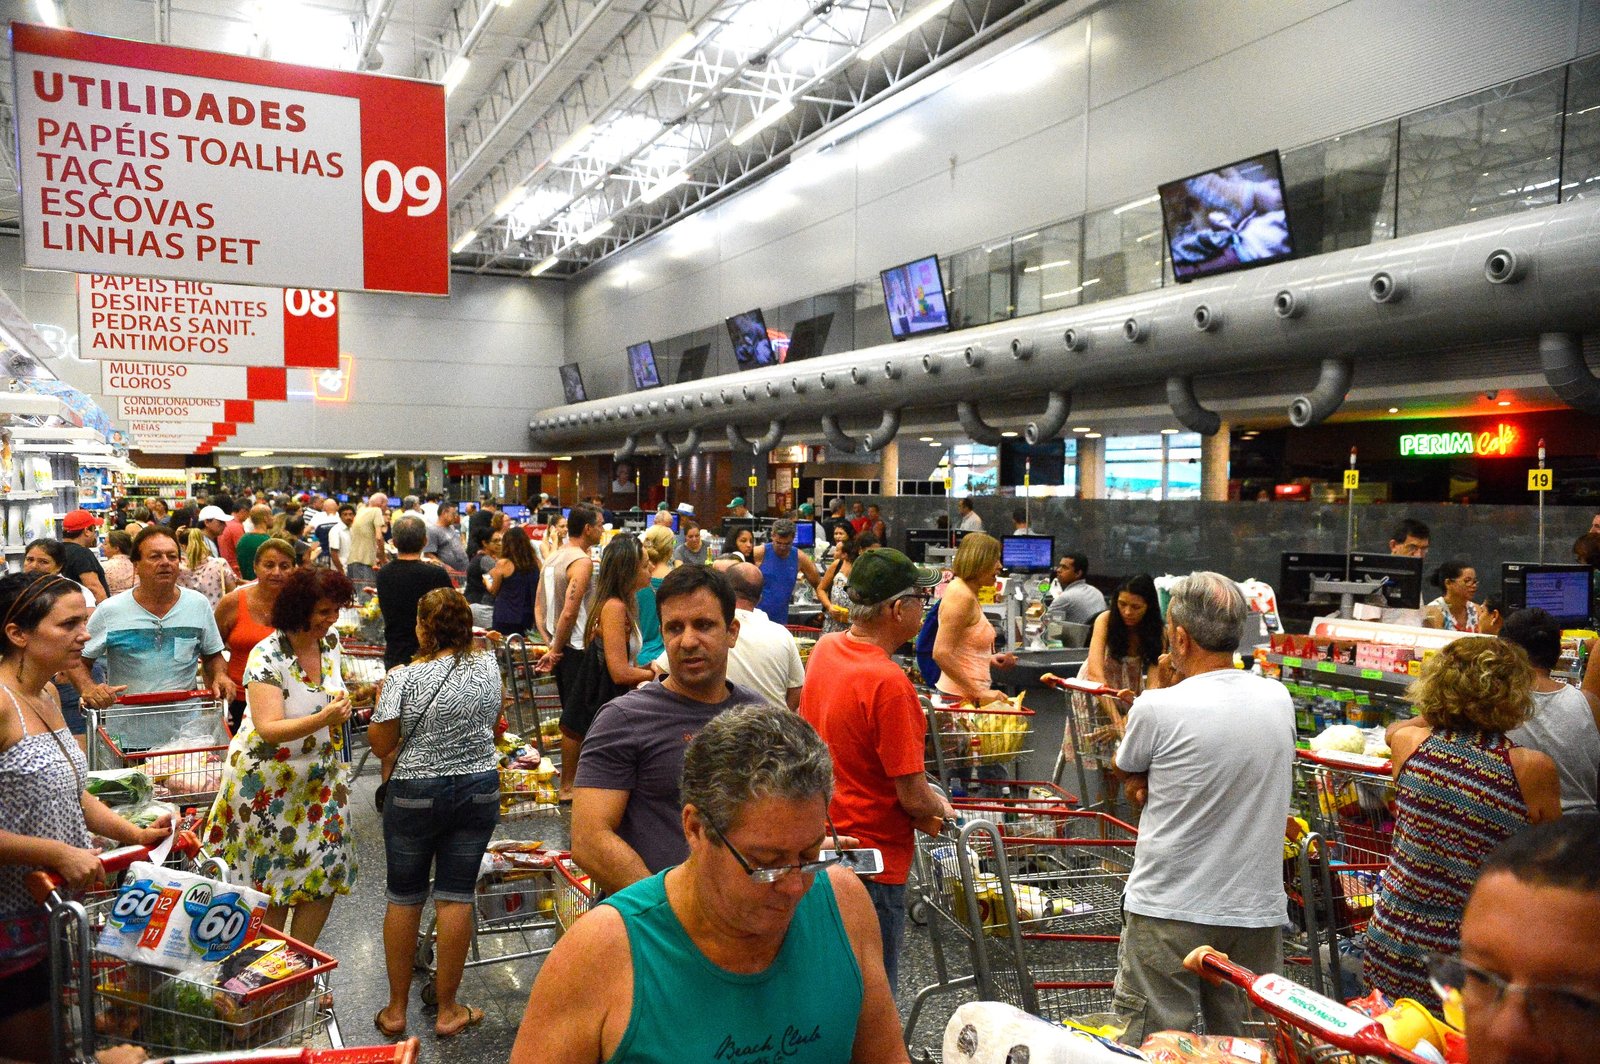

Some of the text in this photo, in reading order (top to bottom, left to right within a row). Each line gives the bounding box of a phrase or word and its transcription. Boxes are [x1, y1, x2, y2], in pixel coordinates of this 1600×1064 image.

[33, 70, 307, 133] UTILIDADES
[37, 118, 344, 178] PAPÉIS TOALHAS
[37, 152, 164, 197] TAÇAS
[363, 160, 442, 217] 09
[40, 187, 215, 229] ESCOVAS
[42, 221, 260, 266] LINHAS PET
[174, 281, 213, 296] HIG
[91, 293, 267, 318] DESINFETANTES
[285, 287, 336, 318] 08
[92, 312, 256, 337] PEDRAS SANIT.
[92, 332, 229, 354] ANTIMOFOS
[110, 362, 187, 377] MULTIUSO
[110, 376, 171, 390] CLOROS
[124, 396, 221, 407] CONDICIONADORES
[124, 406, 189, 416] SHAMPOOS
[132, 422, 160, 431] MEIAS
[1400, 423, 1515, 456] PERIM Café
[1346, 474, 1357, 486] 18
[1532, 473, 1548, 487] 19
[114, 889, 160, 917] 60
[157, 896, 173, 911] 12
[145, 928, 160, 941] 11
[198, 904, 245, 945] 60
[249, 916, 261, 930] 12
[714, 1024, 821, 1060] Beach Club
